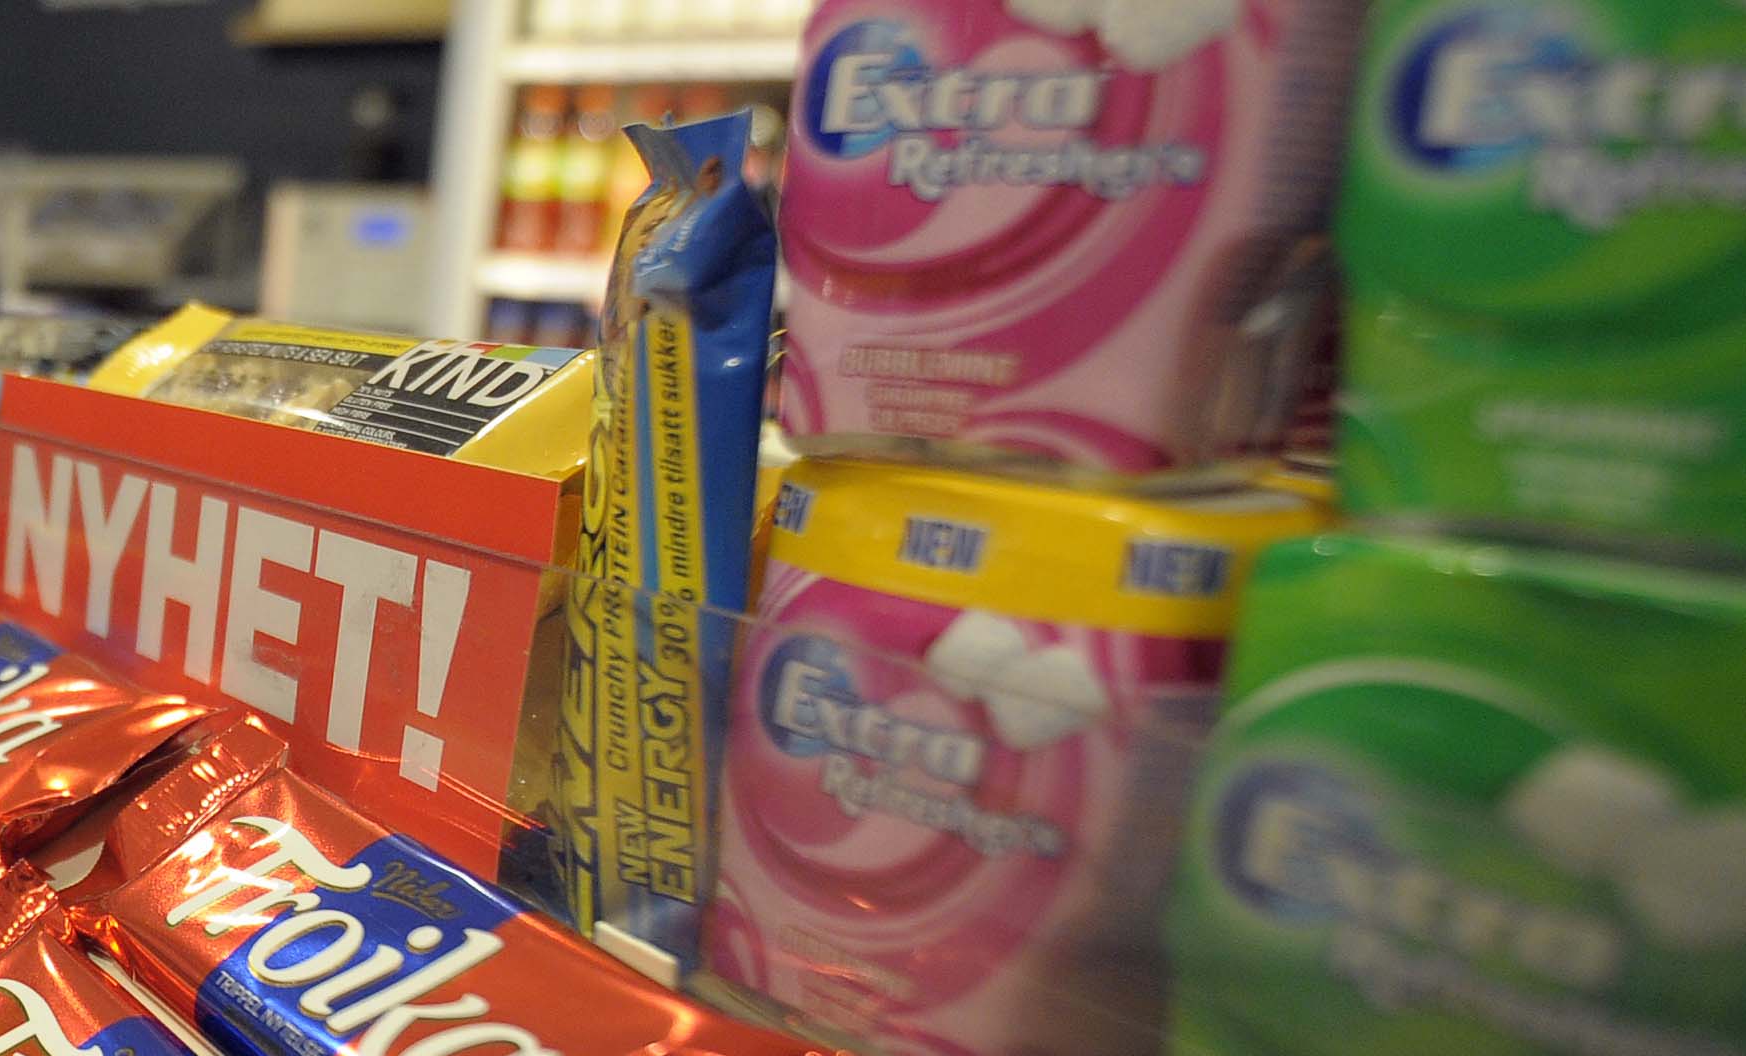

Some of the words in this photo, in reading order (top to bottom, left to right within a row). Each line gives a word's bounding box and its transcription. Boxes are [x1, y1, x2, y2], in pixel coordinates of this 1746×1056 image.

[821, 53, 1098, 133] Extra
[1419, 40, 1746, 142] Extr
[367, 341, 548, 407] KIND
[659, 408, 687, 484] tilsatt
[664, 492, 690, 578] mindre
[772, 483, 811, 534] EW
[904, 517, 988, 572] NEW
[604, 508, 632, 638] PROTEIN
[4, 443, 471, 793] NYHET!
[660, 588, 695, 663] 30%
[604, 649, 630, 771] Crunchy
[775, 659, 981, 787] Extra
[638, 658, 696, 906] ENERGY
[617, 799, 649, 886] NEW
[215, 970, 264, 1018] TRIPPEL
